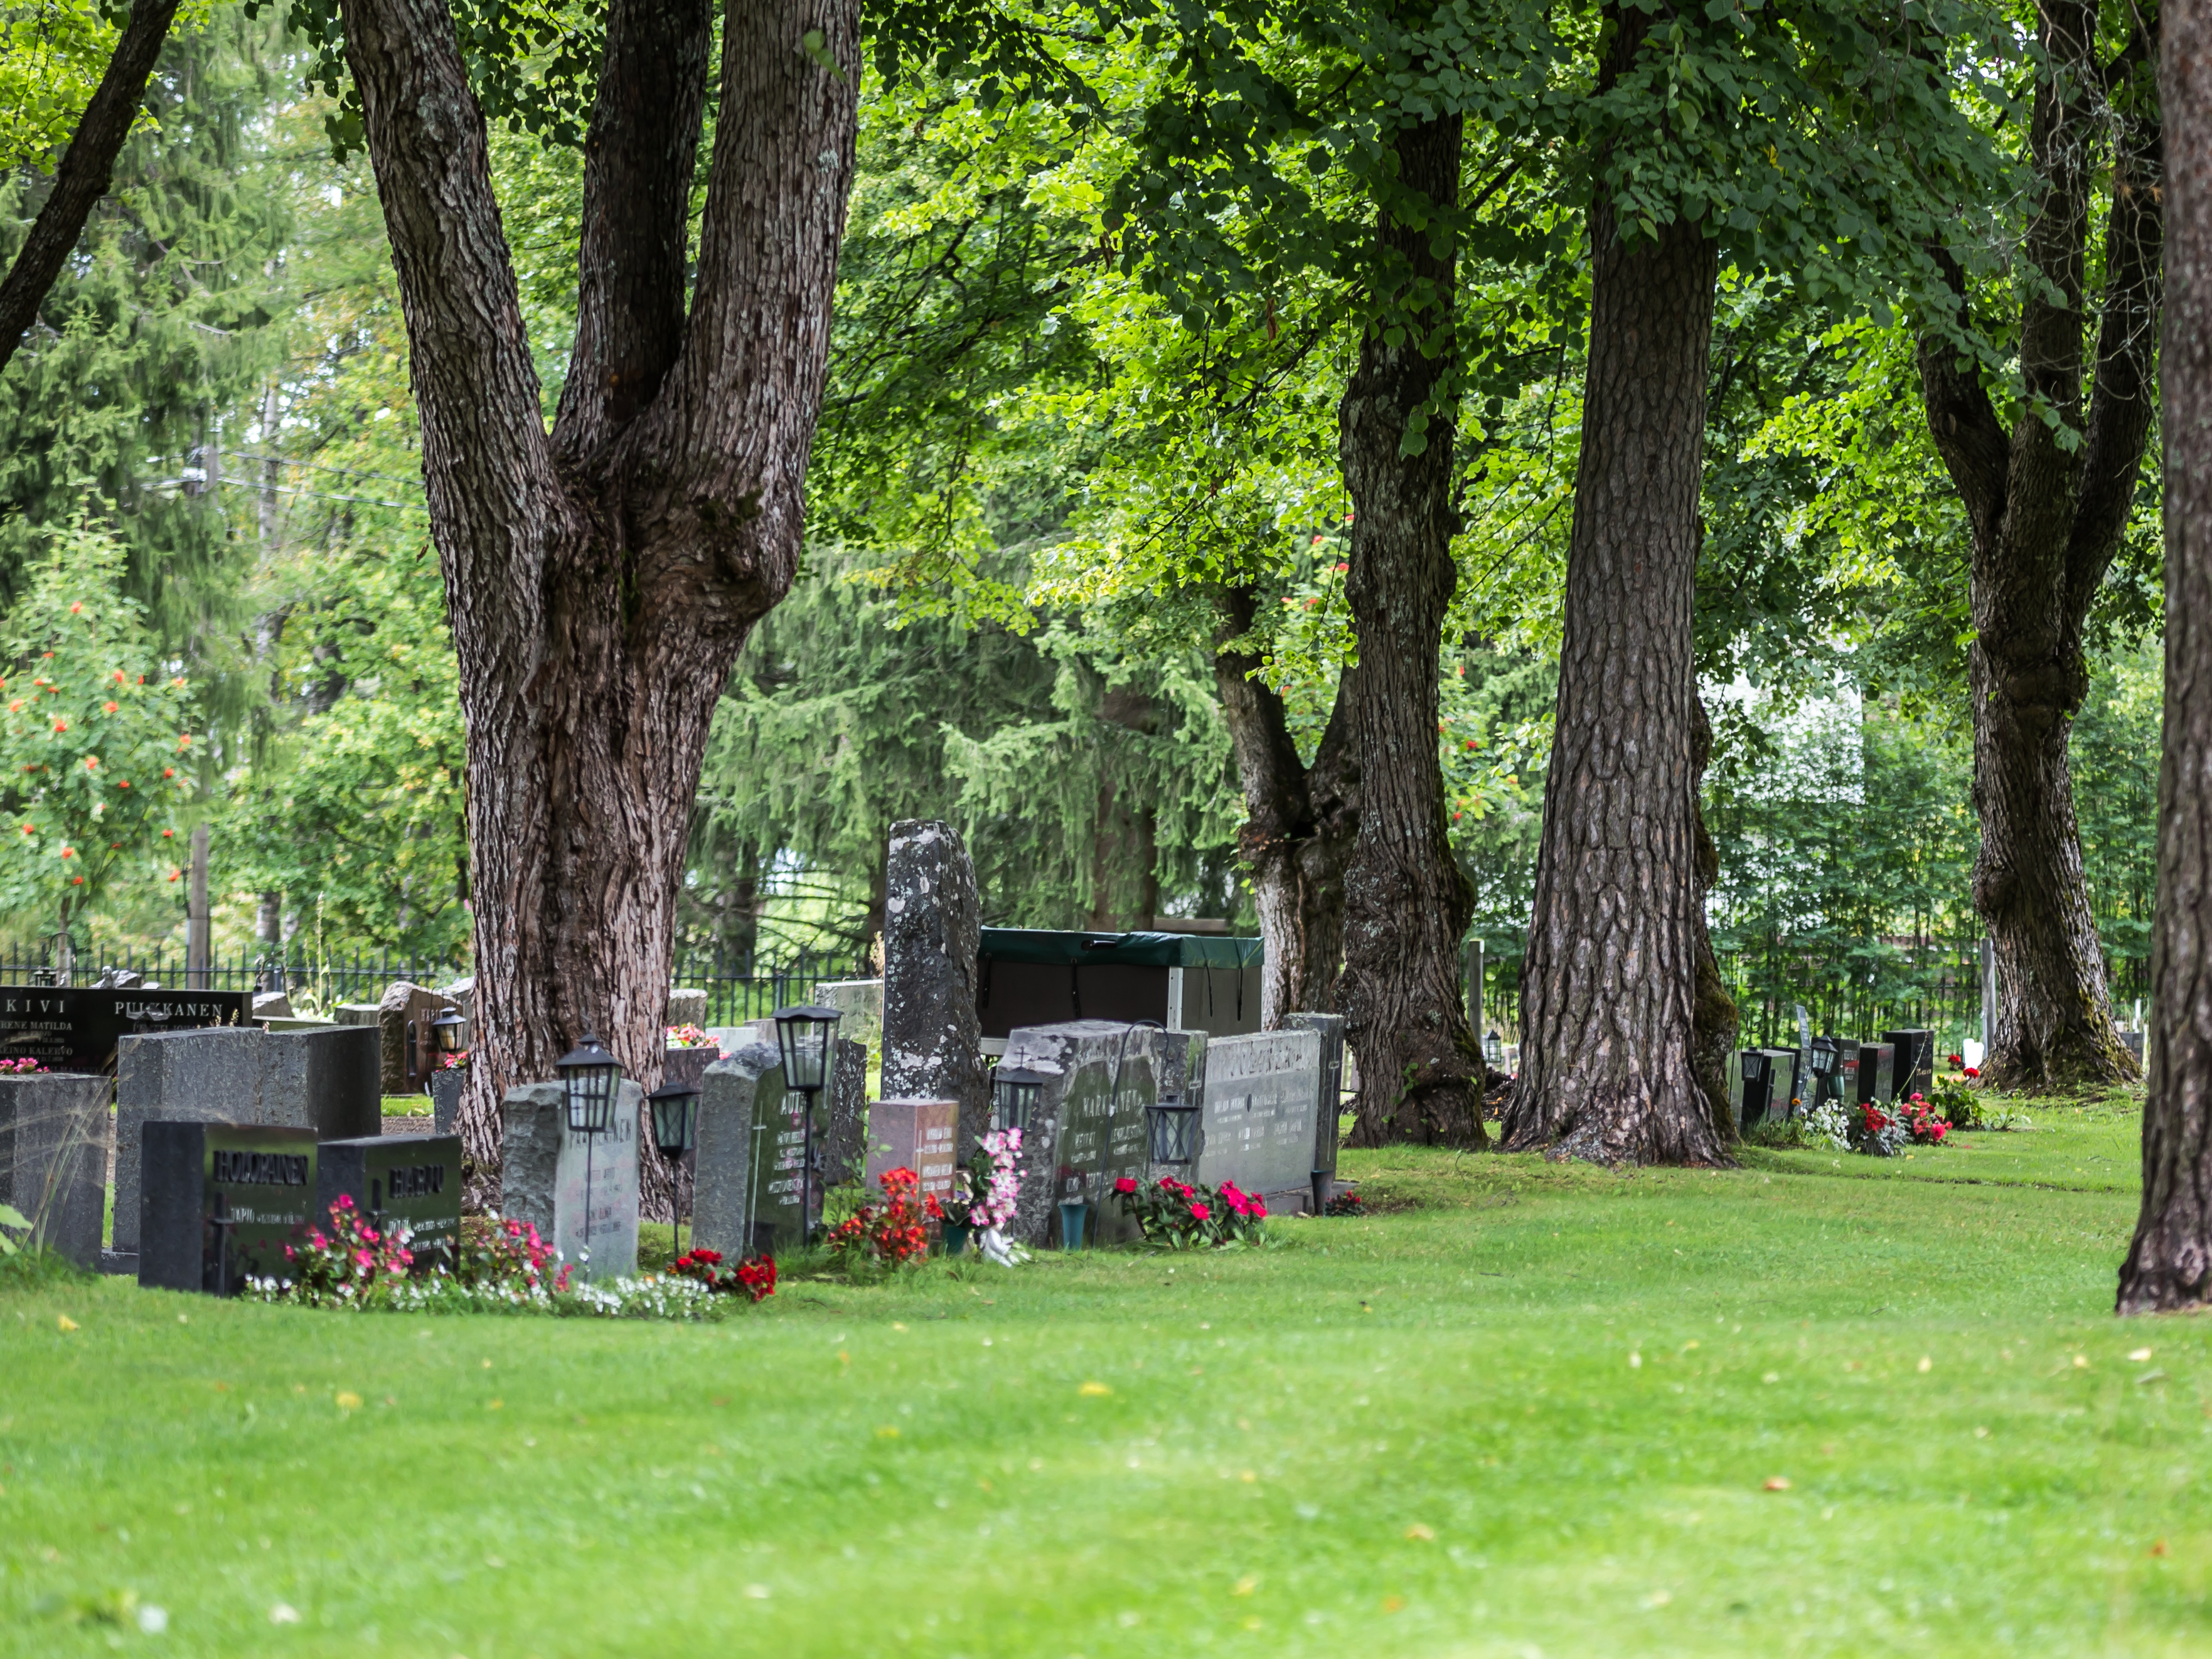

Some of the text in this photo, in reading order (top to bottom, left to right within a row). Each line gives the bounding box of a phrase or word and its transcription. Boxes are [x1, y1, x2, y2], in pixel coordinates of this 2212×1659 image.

[6, 999, 65, 1013] KIVI
[31, 1022, 72, 1030] MATILDA
[214, 1151, 309, 1186] HOLOPAINEN
[389, 1165, 445, 1199] HARJU
